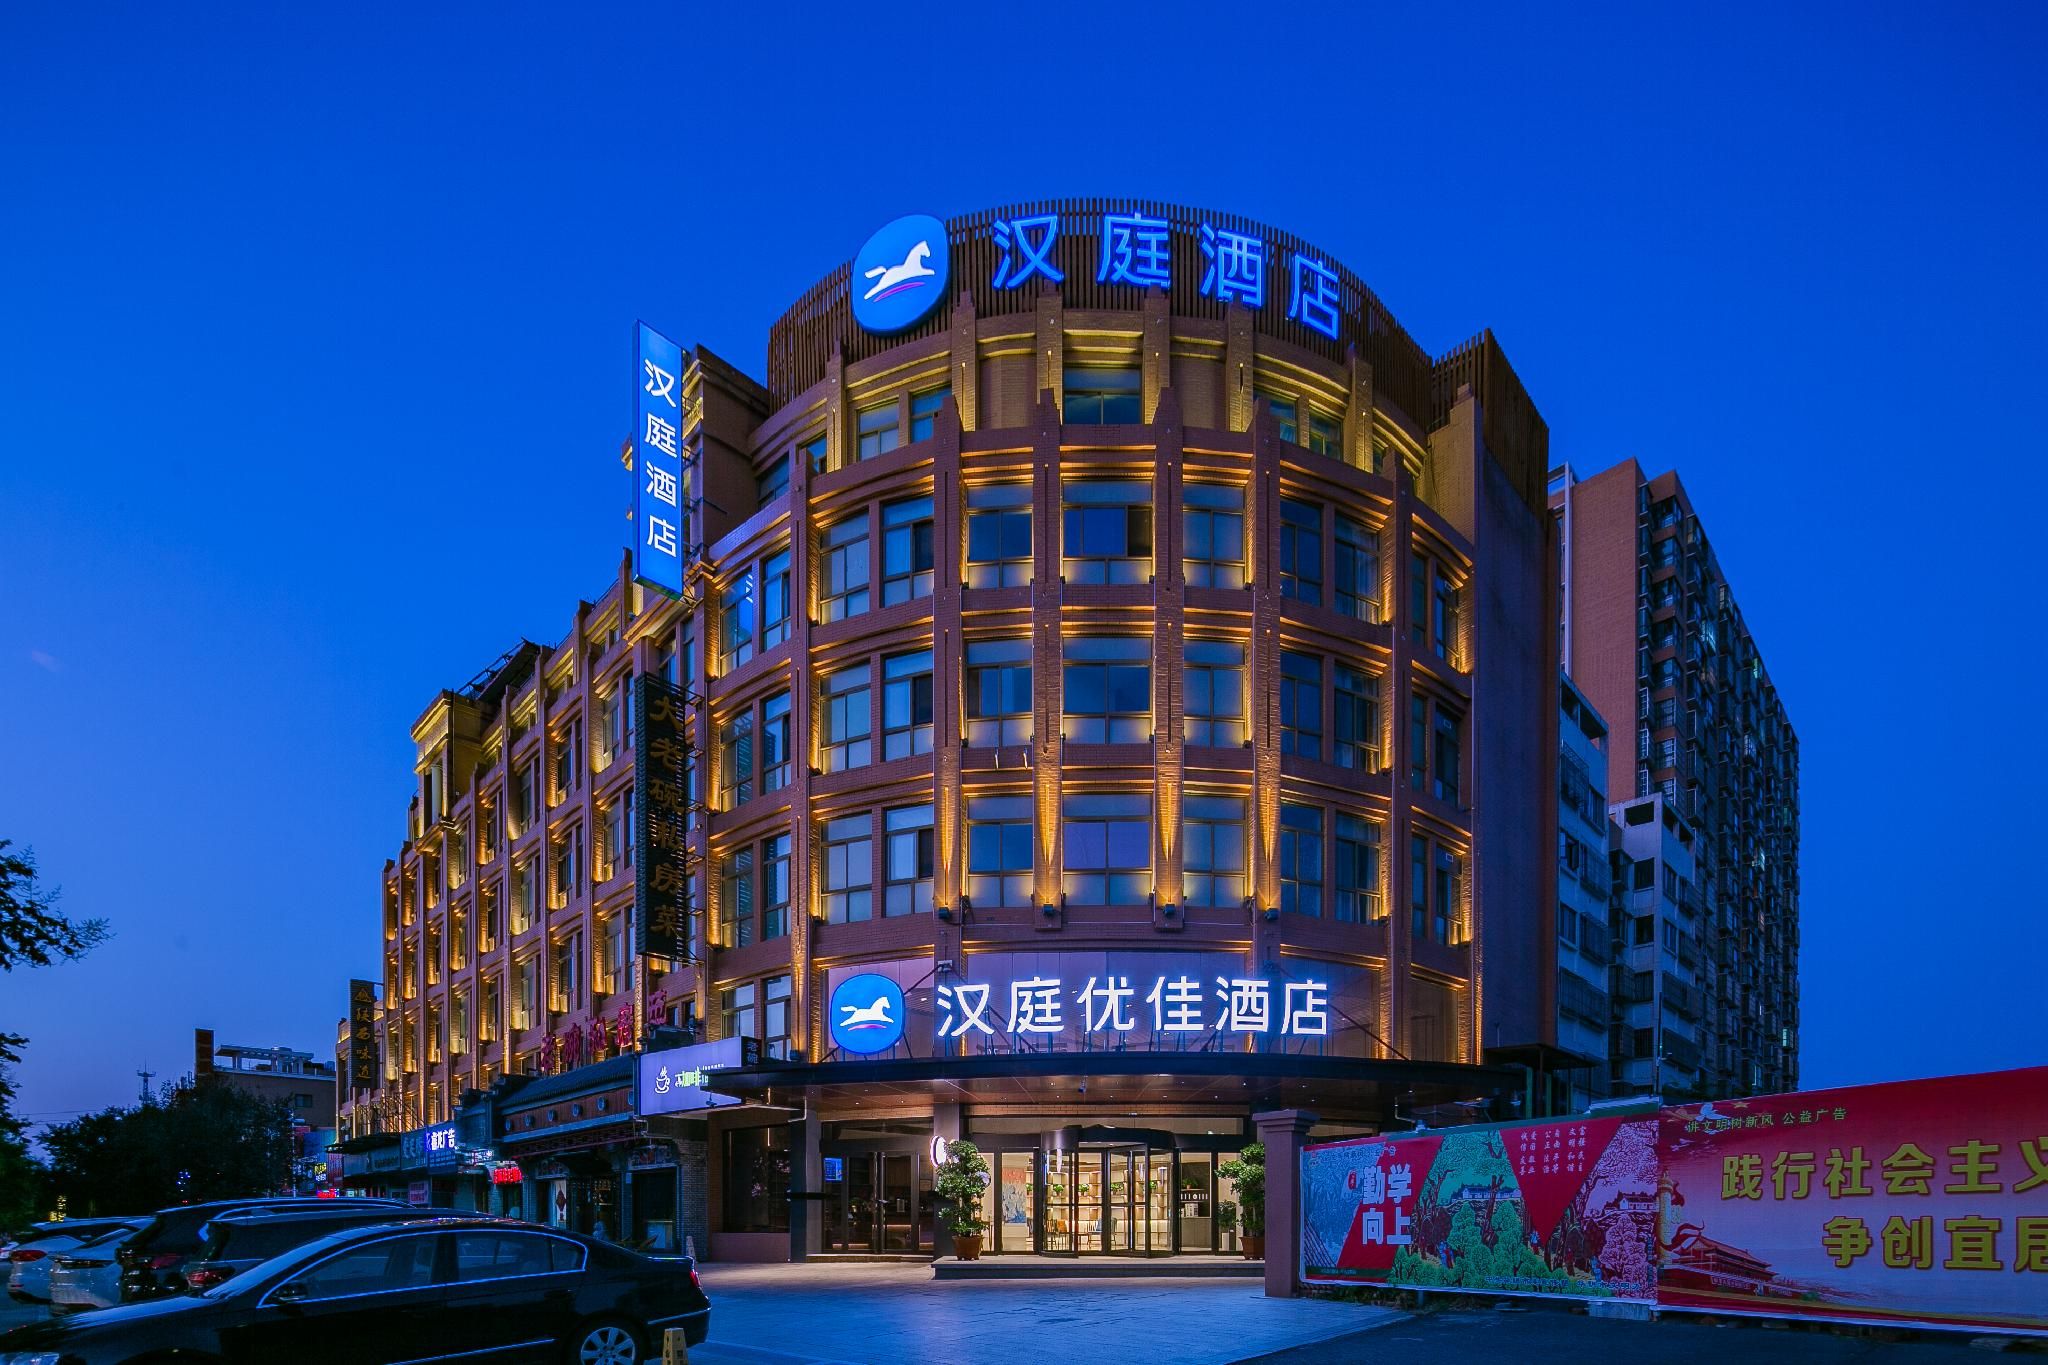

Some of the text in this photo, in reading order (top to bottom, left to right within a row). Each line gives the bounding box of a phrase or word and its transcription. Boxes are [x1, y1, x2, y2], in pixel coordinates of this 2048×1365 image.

[992, 211, 1340, 341] 汉庭酒店
[644, 358, 677, 558] 汉庭酒店
[649, 695, 684, 938] 大老碗私房菜
[935, 976, 1330, 1038] 汉庭优佳酒店
[1686, 1107, 1847, 1133] 讲文明树新风 公益广告
[1362, 1163, 1412, 1204] 勤学
[1362, 1207, 1412, 1245] 向上
